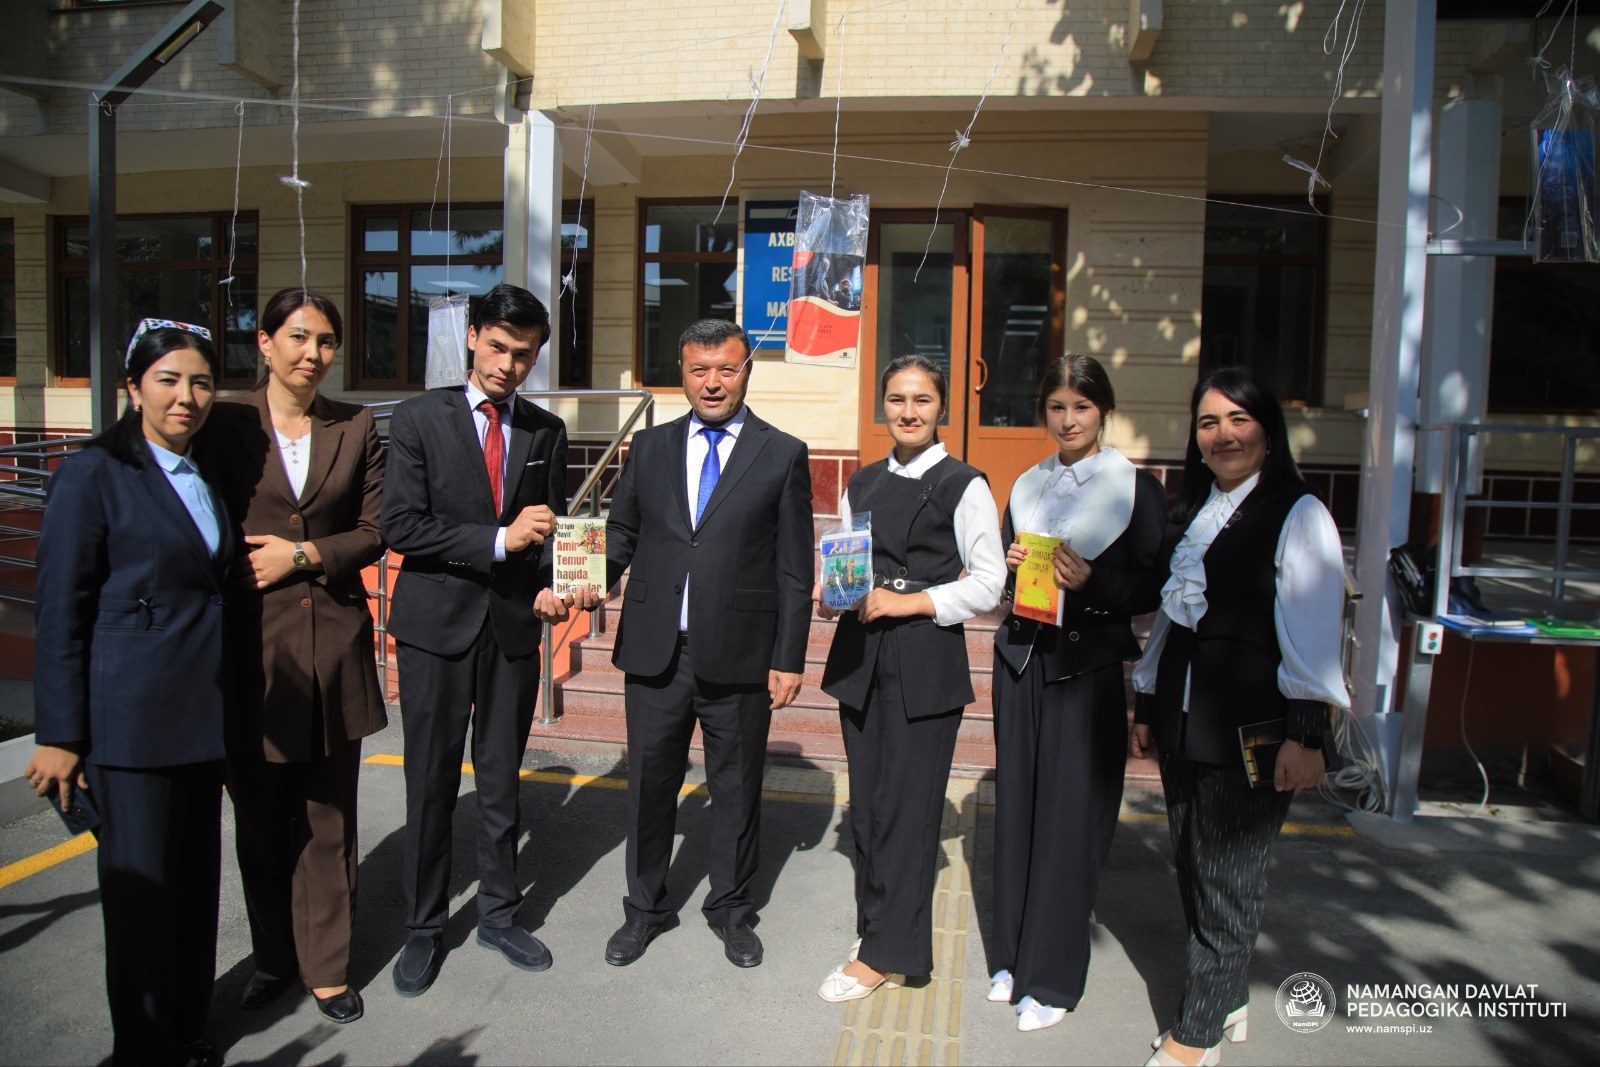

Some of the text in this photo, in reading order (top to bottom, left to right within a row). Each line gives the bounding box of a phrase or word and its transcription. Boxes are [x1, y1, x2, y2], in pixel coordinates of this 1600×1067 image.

[768, 231, 795, 248] AXB
[772, 266, 792, 282] RES
[767, 301, 788, 318] MA
[557, 540, 579, 552] Amir
[557, 554, 588, 566] Temur
[557, 569, 588, 581] haqida
